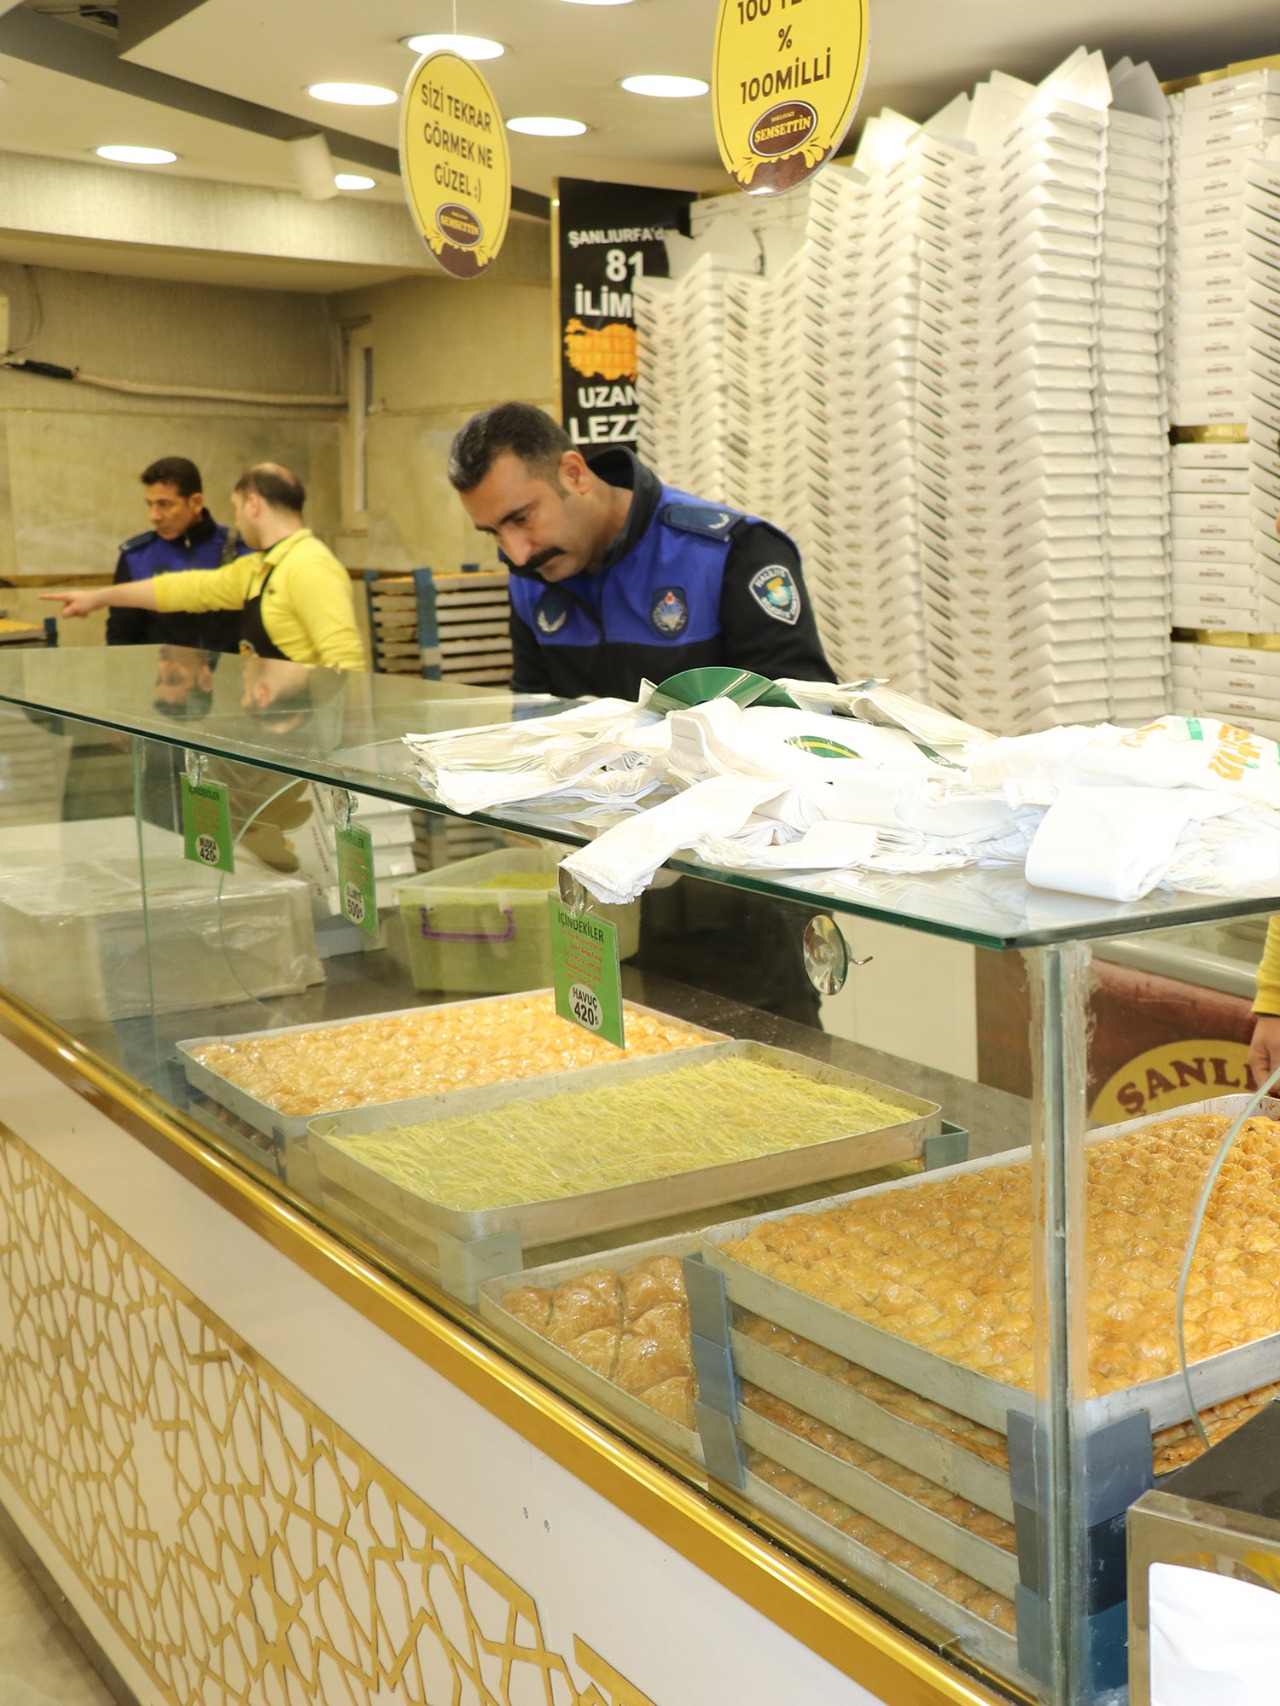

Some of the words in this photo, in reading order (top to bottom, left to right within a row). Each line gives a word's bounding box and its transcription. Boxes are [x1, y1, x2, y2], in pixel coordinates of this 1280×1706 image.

[778, 24, 793, 52] %
[740, 46, 832, 104] 100MİLLİ
[420, 80, 444, 109] SİZİ
[446, 94, 492, 134] TEKRAR
[424, 120, 475, 163] GÖRMEK
[478, 146, 493, 170] NE
[434, 161, 472, 197] GÜZEL
[606, 248, 644, 282] 81
[572, 986, 598, 1012] HAVUÇ
